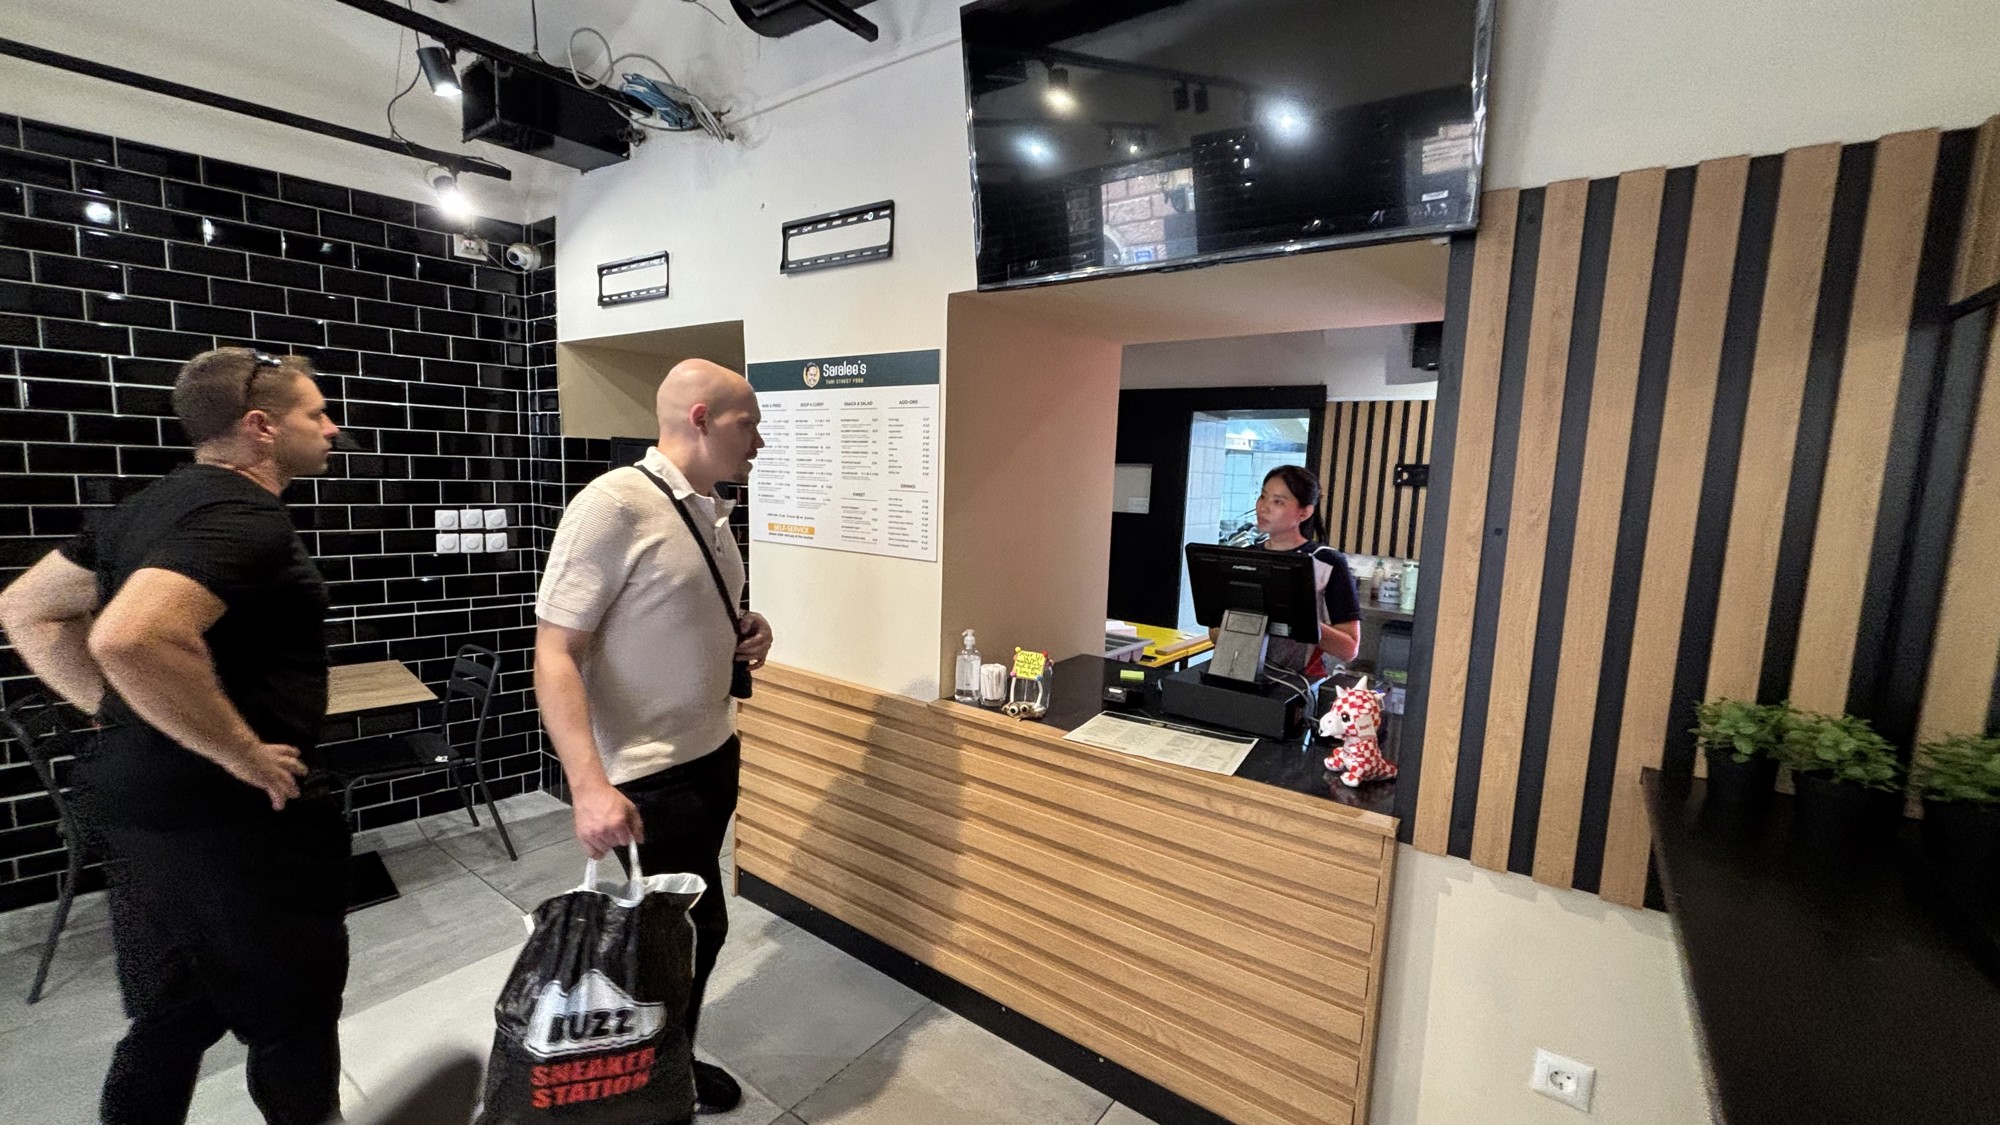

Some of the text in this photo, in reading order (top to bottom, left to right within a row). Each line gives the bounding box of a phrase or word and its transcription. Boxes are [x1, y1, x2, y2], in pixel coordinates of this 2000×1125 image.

[823, 360, 867, 377] Saralee's
[773, 524, 808, 533] SELF-SERVICE
[531, 1047, 655, 1086] SNEAKER
[532, 1071, 649, 1108] STATION
